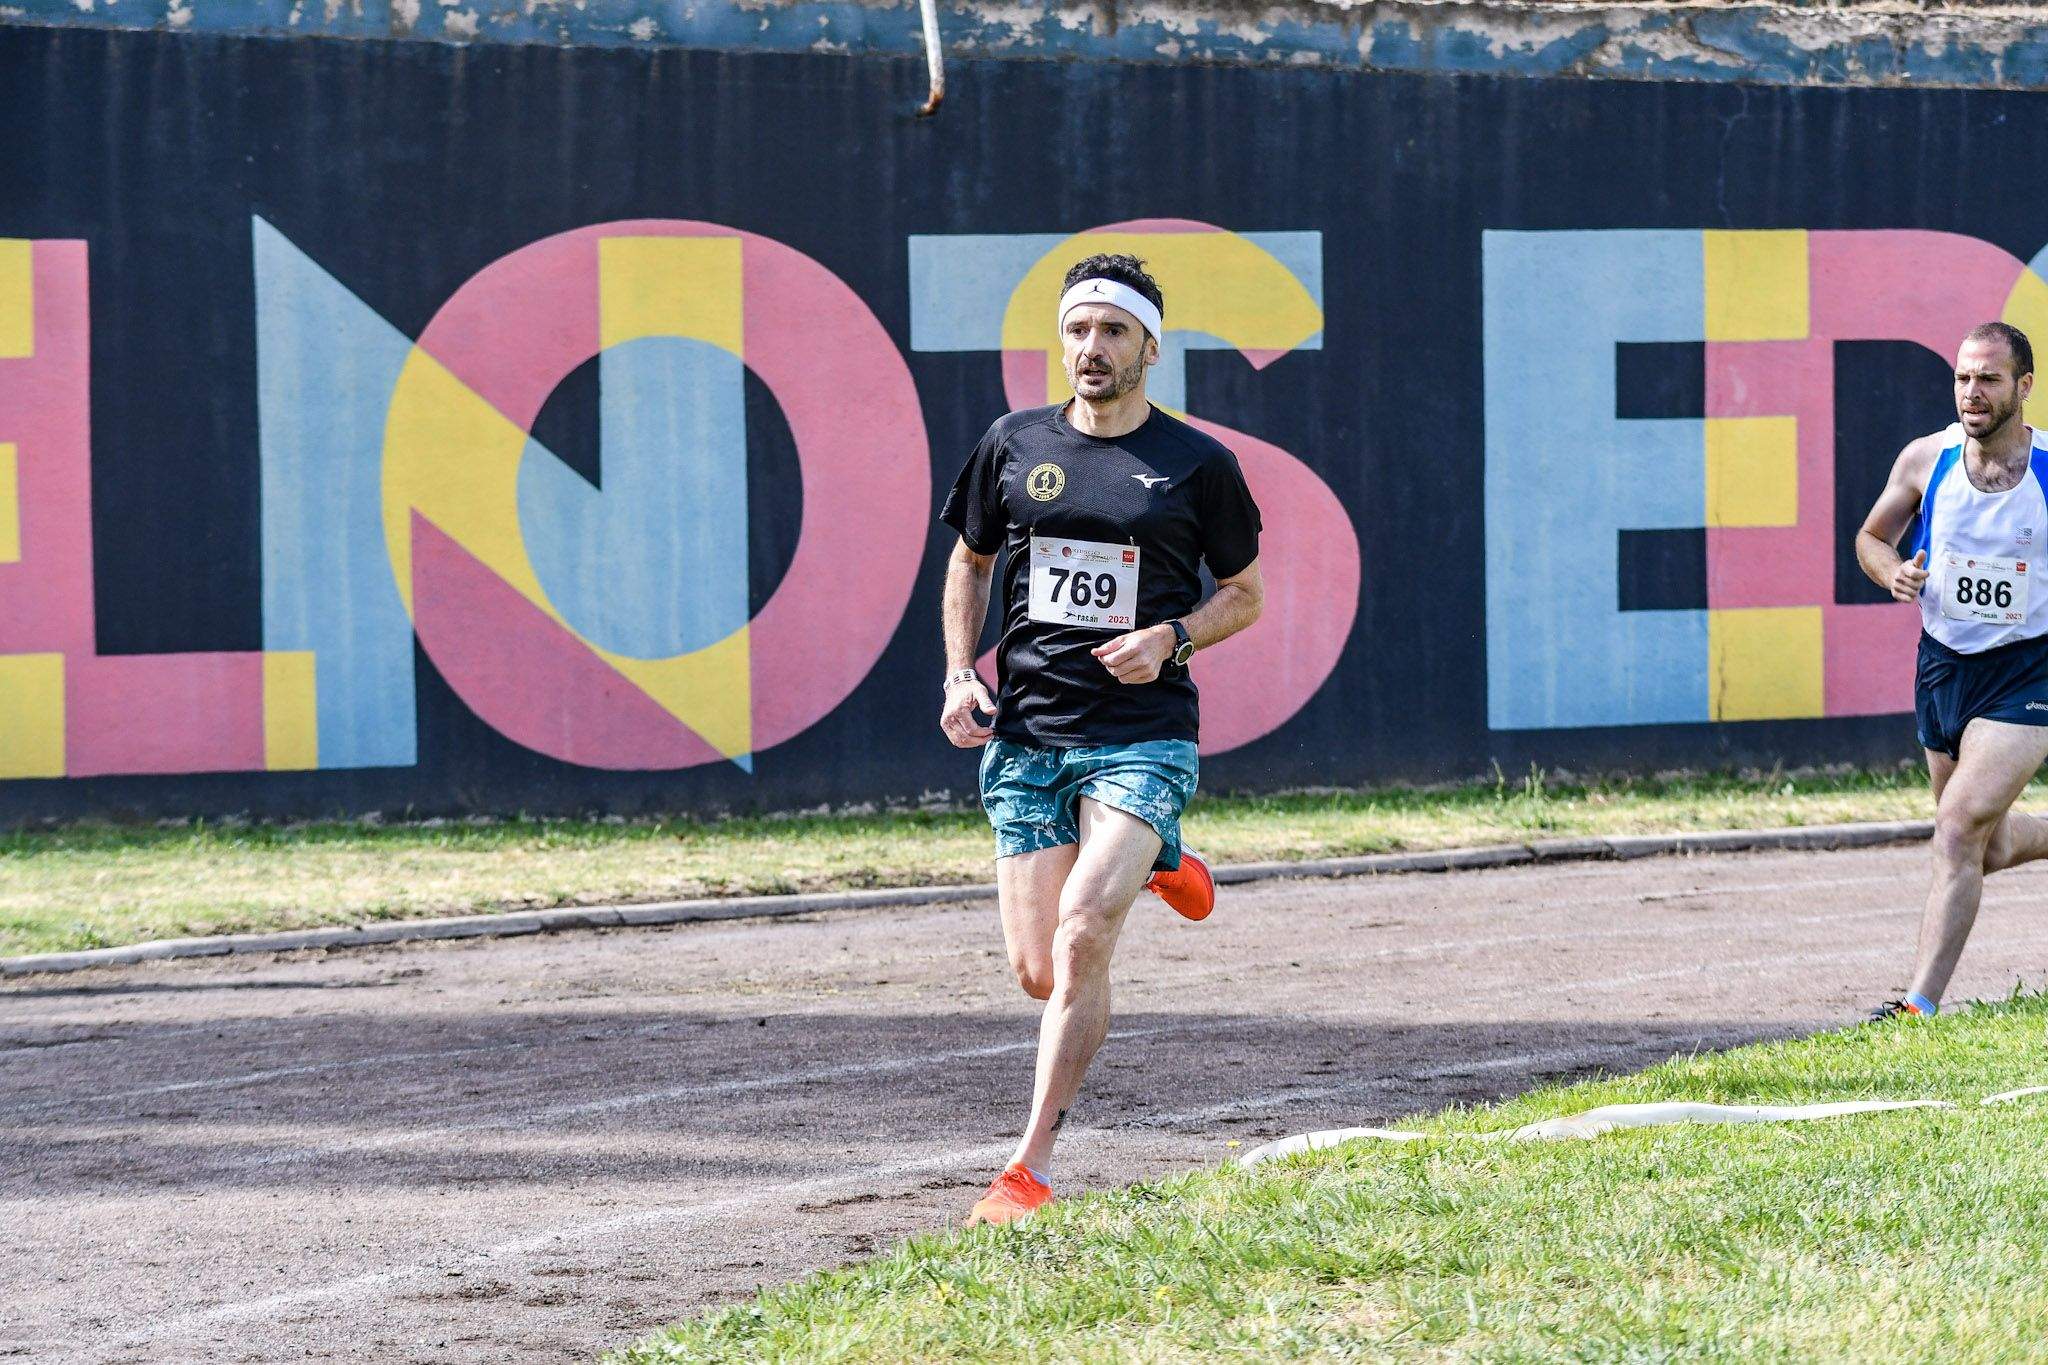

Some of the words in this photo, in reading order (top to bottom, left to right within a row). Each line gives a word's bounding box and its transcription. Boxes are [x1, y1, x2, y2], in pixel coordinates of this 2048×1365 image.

[1049, 566, 1117, 609] 769
[1956, 576, 2012, 608] 886
[1108, 615, 1130, 624] 2023
[2005, 612, 2023, 620] 2023
